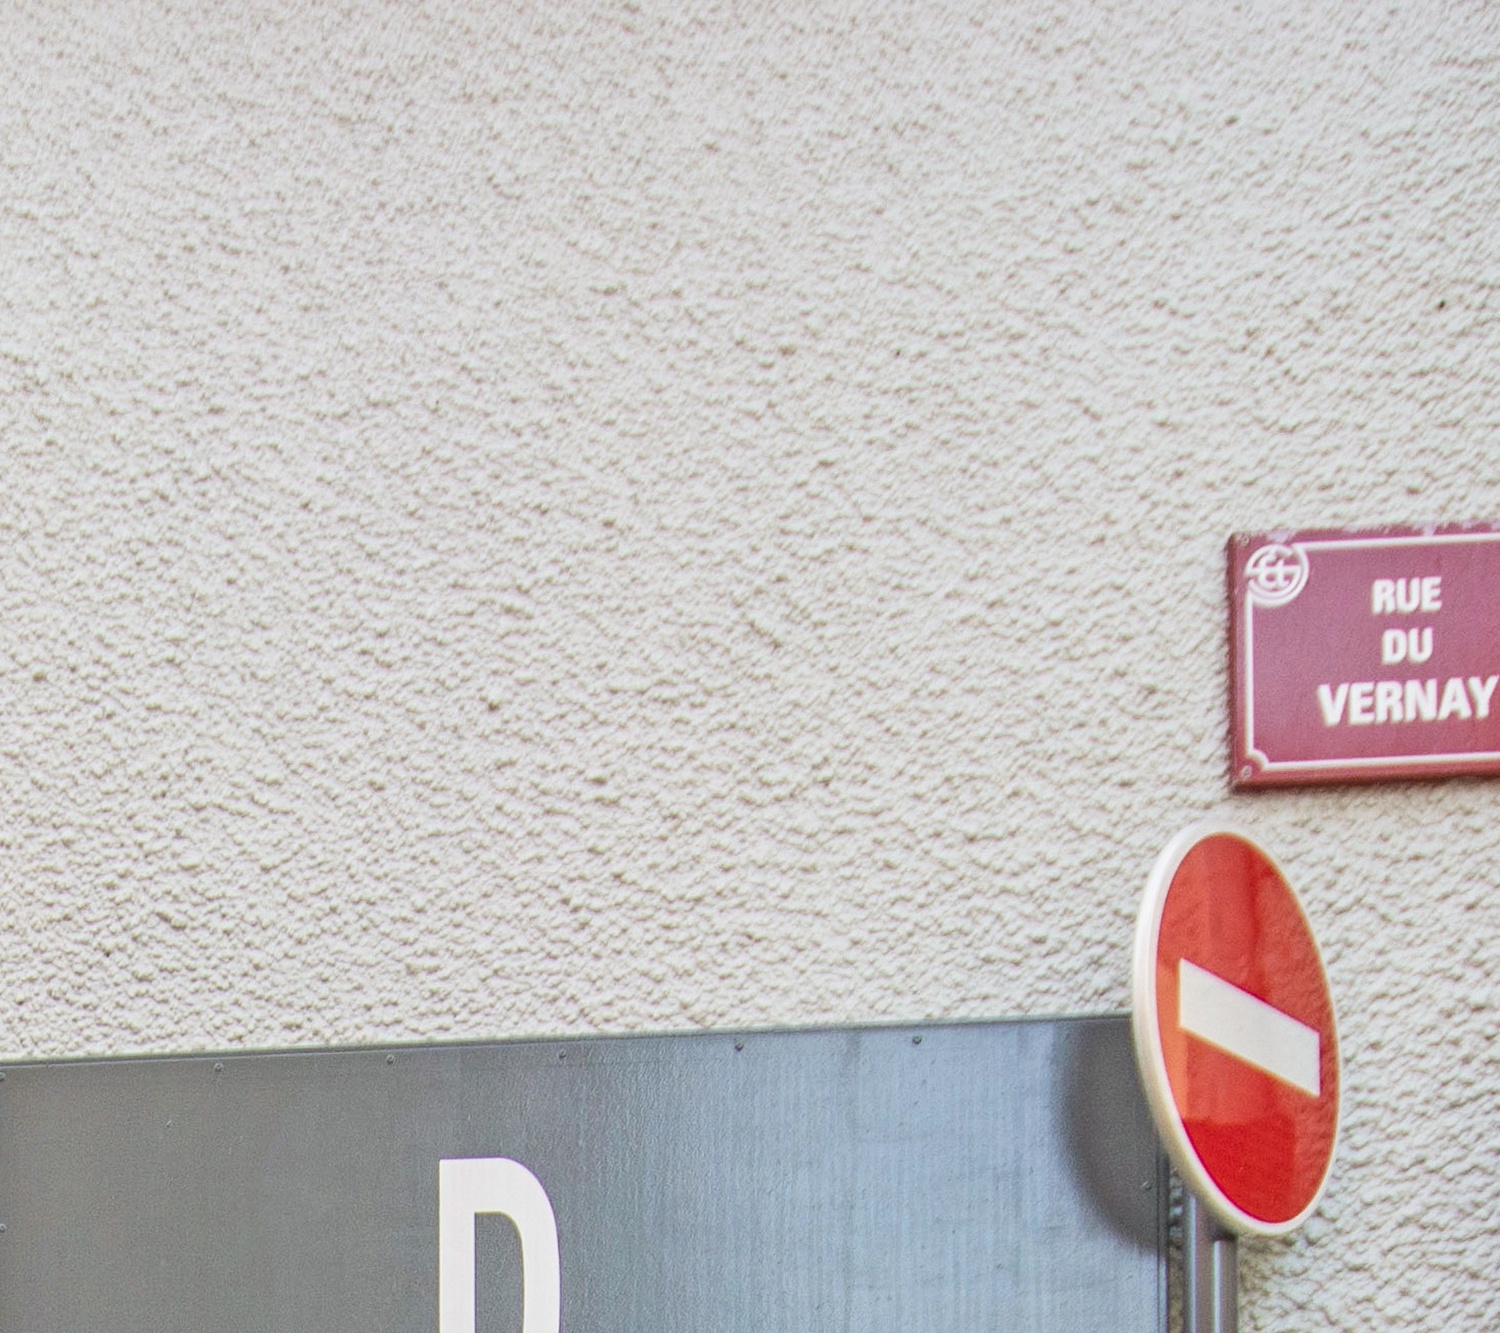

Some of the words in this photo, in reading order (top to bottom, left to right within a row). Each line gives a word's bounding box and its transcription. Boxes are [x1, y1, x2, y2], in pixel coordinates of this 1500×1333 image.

[1371, 576, 1442, 618] RUE
[1381, 627, 1434, 666] DU
[1317, 674, 1499, 726] VERNAY
